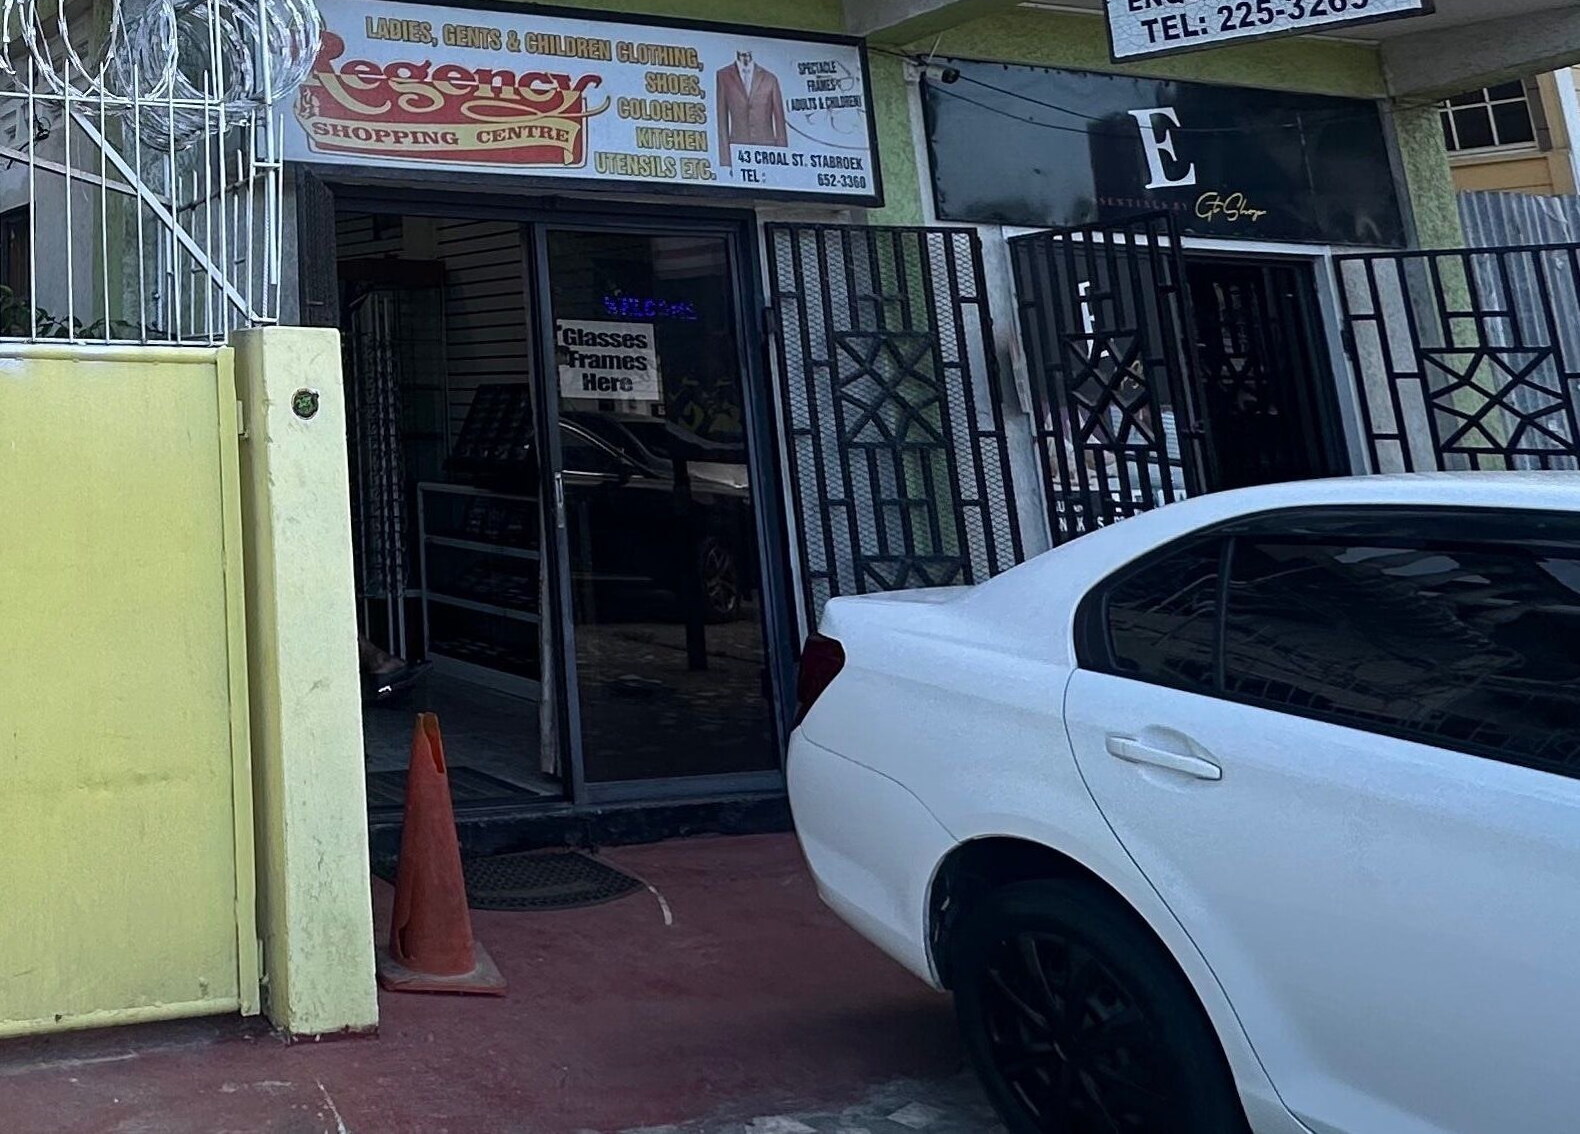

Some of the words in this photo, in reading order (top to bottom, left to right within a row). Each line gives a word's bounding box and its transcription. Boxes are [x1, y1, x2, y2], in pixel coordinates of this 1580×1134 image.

[365, 15, 438, 47] LADIES,
[442, 23, 503, 51] GENTS
[506, 30, 521, 53] &
[524, 32, 613, 62] CHILDREN
[615, 40, 705, 73] CLOTHING,
[1140, 14, 1209, 44] TEL:
[304, 29, 611, 123] Regency
[644, 70, 706, 100] SHOES,
[616, 96, 708, 126] COLOGNES
[310, 121, 459, 146] SHOPPING
[475, 124, 570, 144] CENTRE
[635, 126, 709, 153] KITCHEN
[1127, 106, 1197, 190] E
[593, 150, 678, 179] UTENSILS
[679, 157, 718, 181] ETC.
[737, 150, 752, 165] 43
[754, 150, 790, 166] CROAL
[810, 154, 864, 171] STABROEK
[562, 327, 649, 350] Glasses
[568, 349, 649, 371] Frames
[581, 372, 634, 393] Here
